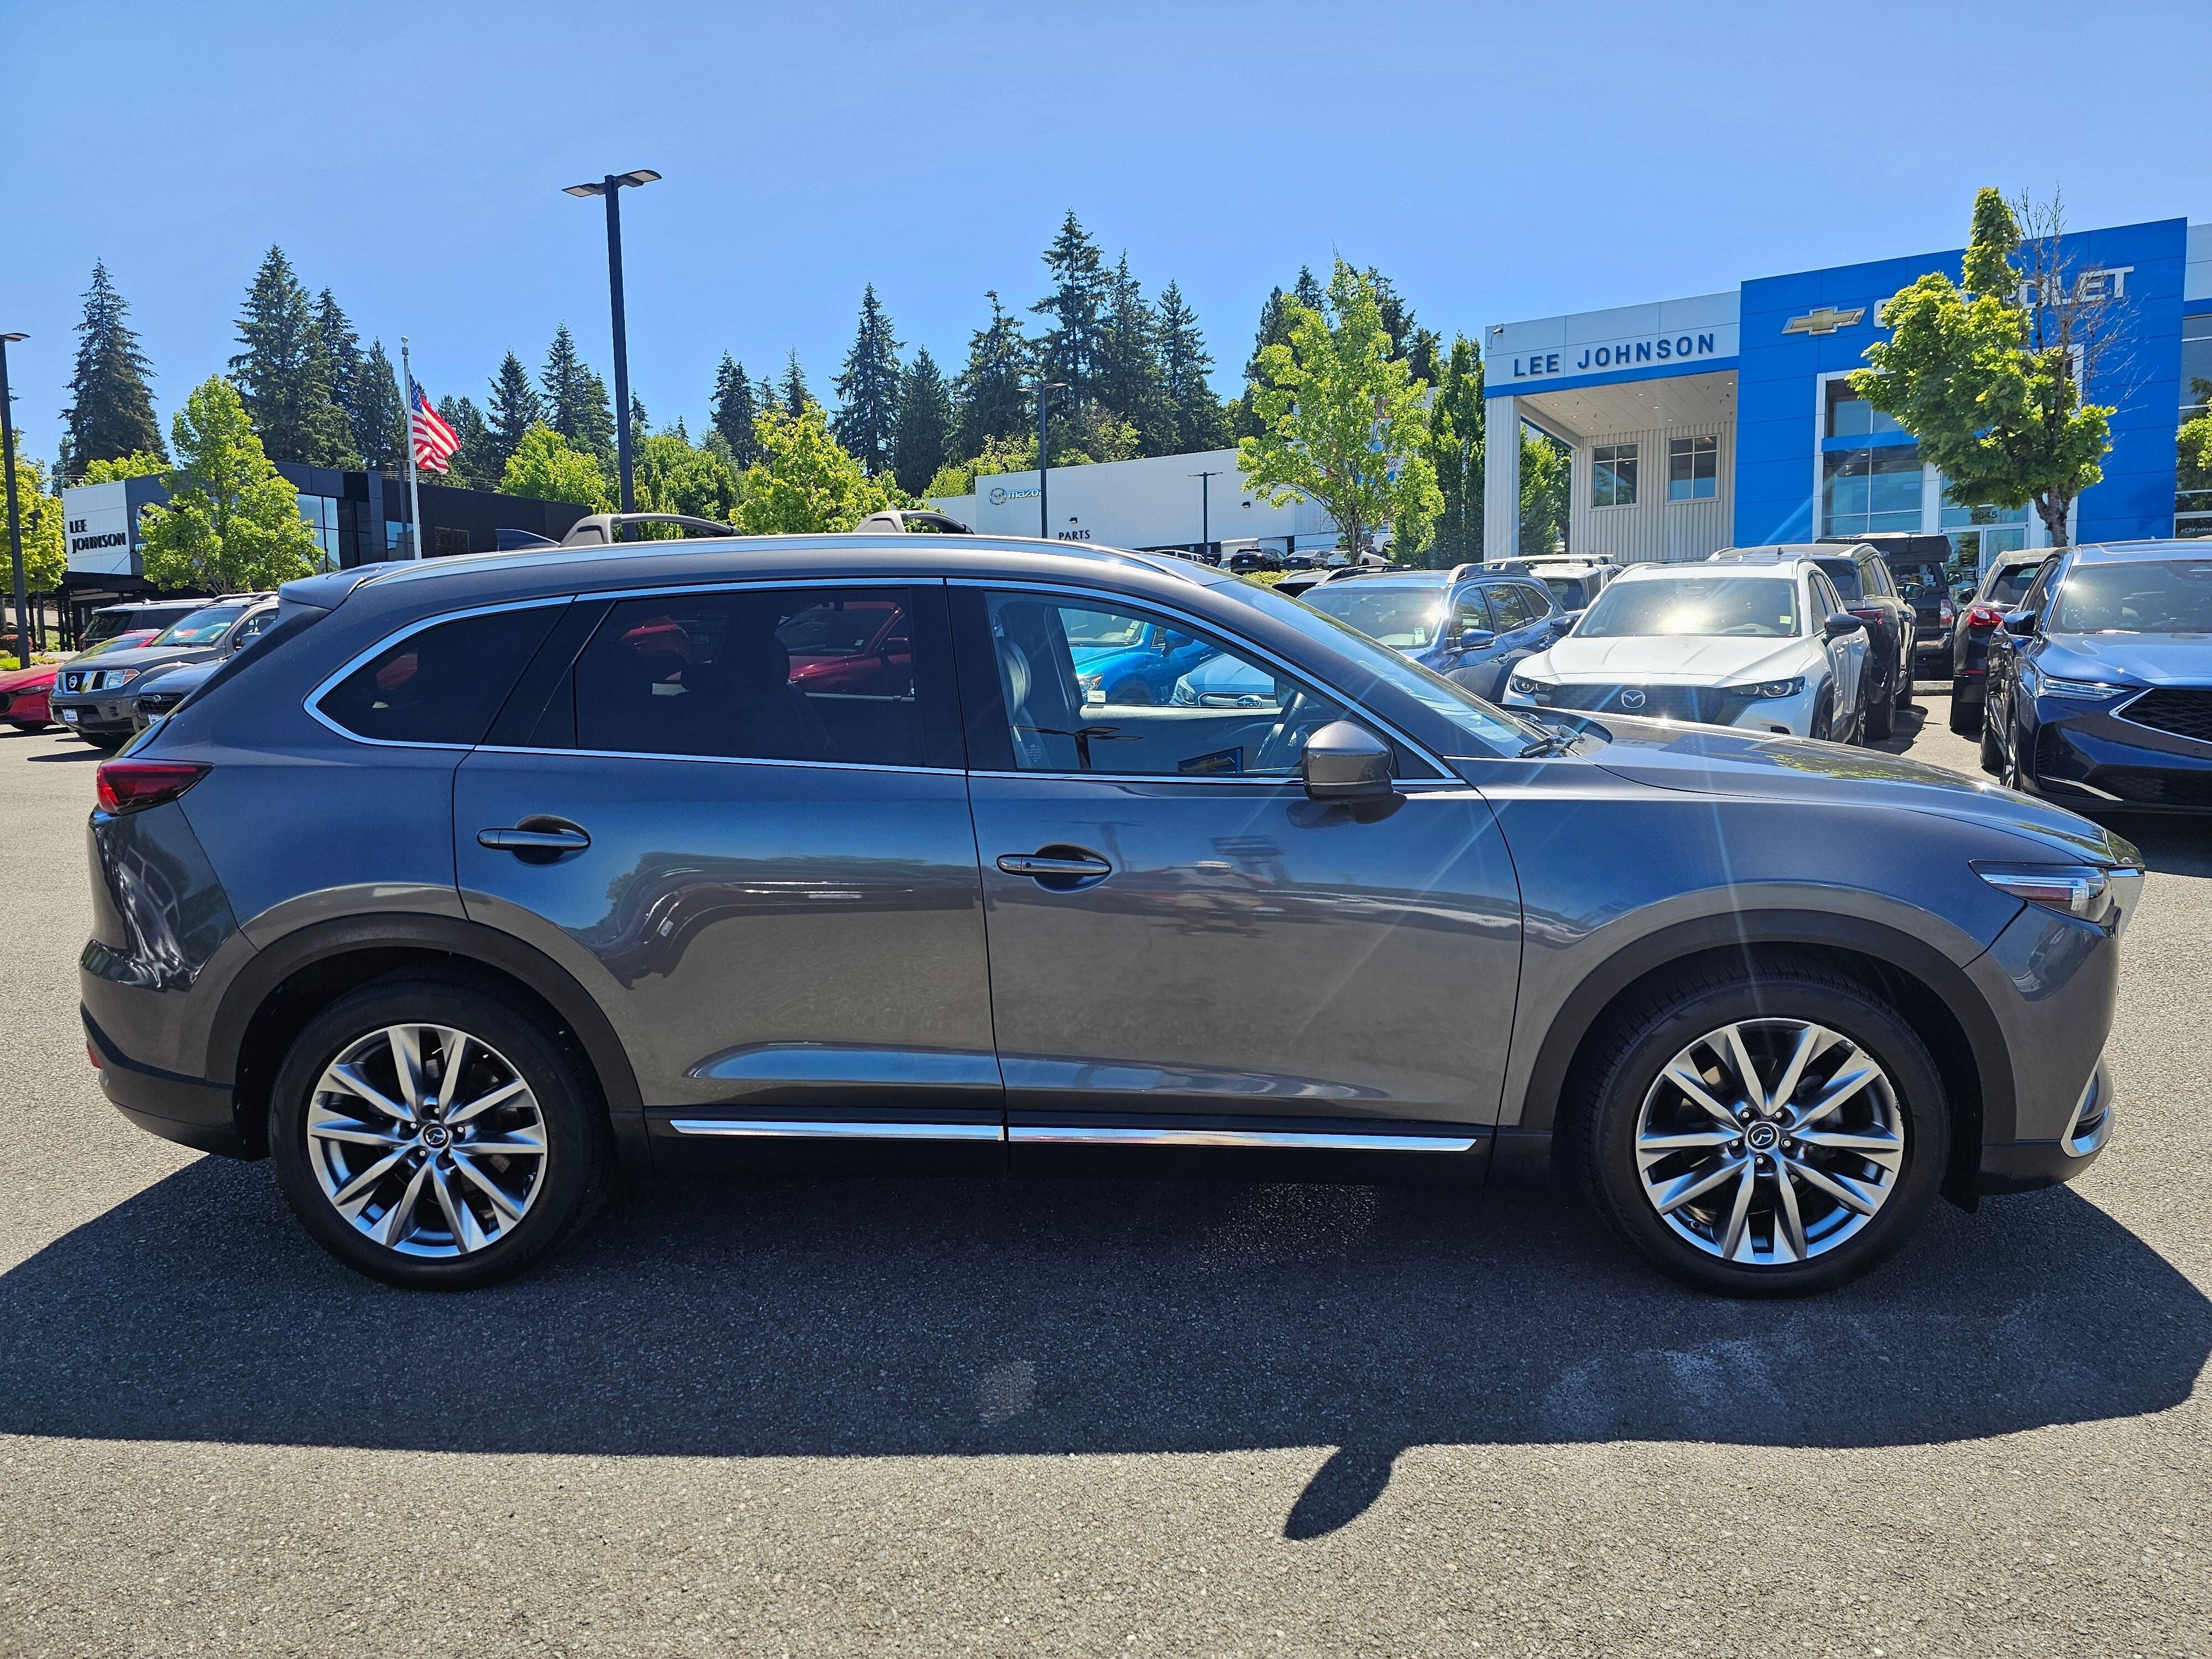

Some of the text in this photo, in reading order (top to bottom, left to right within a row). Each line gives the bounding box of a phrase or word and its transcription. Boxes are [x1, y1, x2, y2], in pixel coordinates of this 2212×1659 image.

[1874, 267, 2134, 327] COLET
[1514, 333, 1714, 377] LEE JOHNSON
[1970, 511, 1997, 520] 11845
[69, 519, 87, 534] LEE
[1058, 529, 1090, 540] PARTS
[72, 532, 127, 554] JOHNSON
